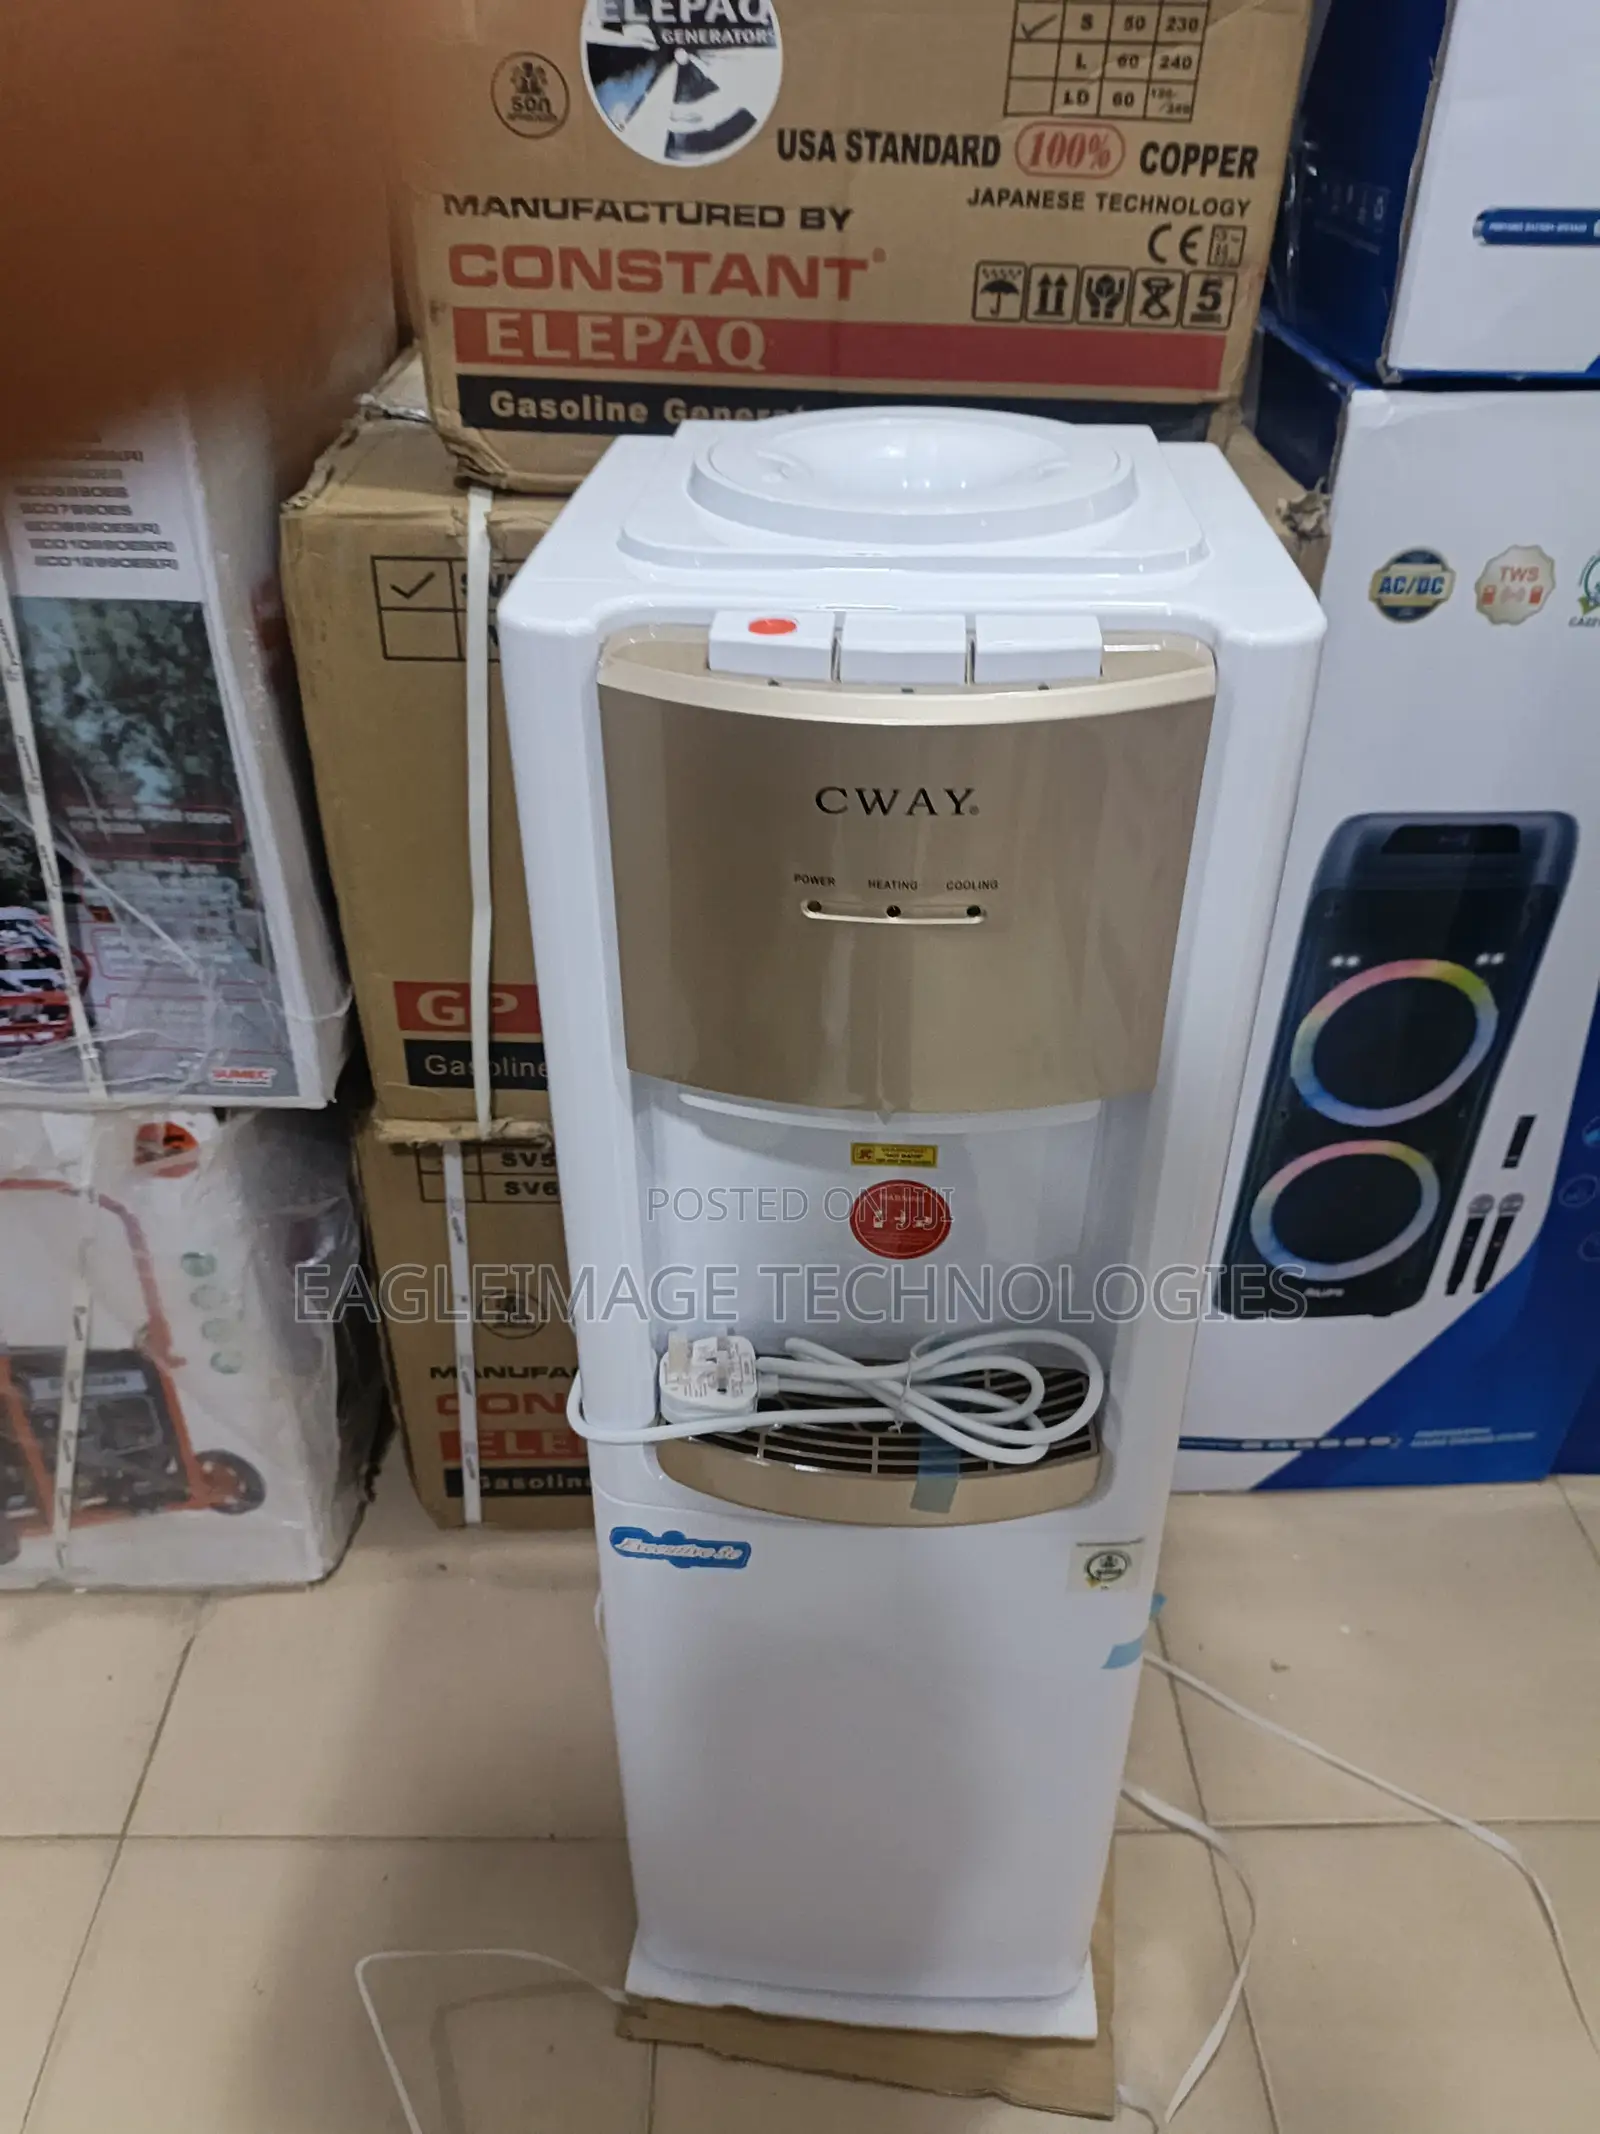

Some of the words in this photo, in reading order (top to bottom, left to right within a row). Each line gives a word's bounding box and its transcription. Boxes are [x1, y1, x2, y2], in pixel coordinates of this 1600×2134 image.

[600, 0, 769, 26] ELEPAQ
[1080, 13, 1094, 31] S
[1124, 15, 1146, 32] 50
[1165, 17, 1199, 33] 230
[1159, 55, 1193, 70] 240
[777, 128, 837, 162] USA
[846, 128, 1001, 168] STANDARD
[1028, 131, 1112, 168] 100%
[1140, 142, 1259, 179] COPPER
[443, 194, 785, 229] MANUFACTURED
[800, 205, 855, 232] BY
[967, 187, 1085, 212] JAPANESE
[1095, 192, 1251, 218] TECHNOLOGY
[448, 243, 869, 301] CONSTANT
[485, 311, 766, 371] ELEPAQ
[490, 390, 649, 424] Gasoline
[1378, 575, 1445, 596] AC/DC
[1501, 565, 1540, 583] TWS
[815, 786, 974, 816] CWAY
[794, 873, 836, 887] POWER
[868, 879, 918, 891] HEATING
[946, 879, 999, 891] COOLING
